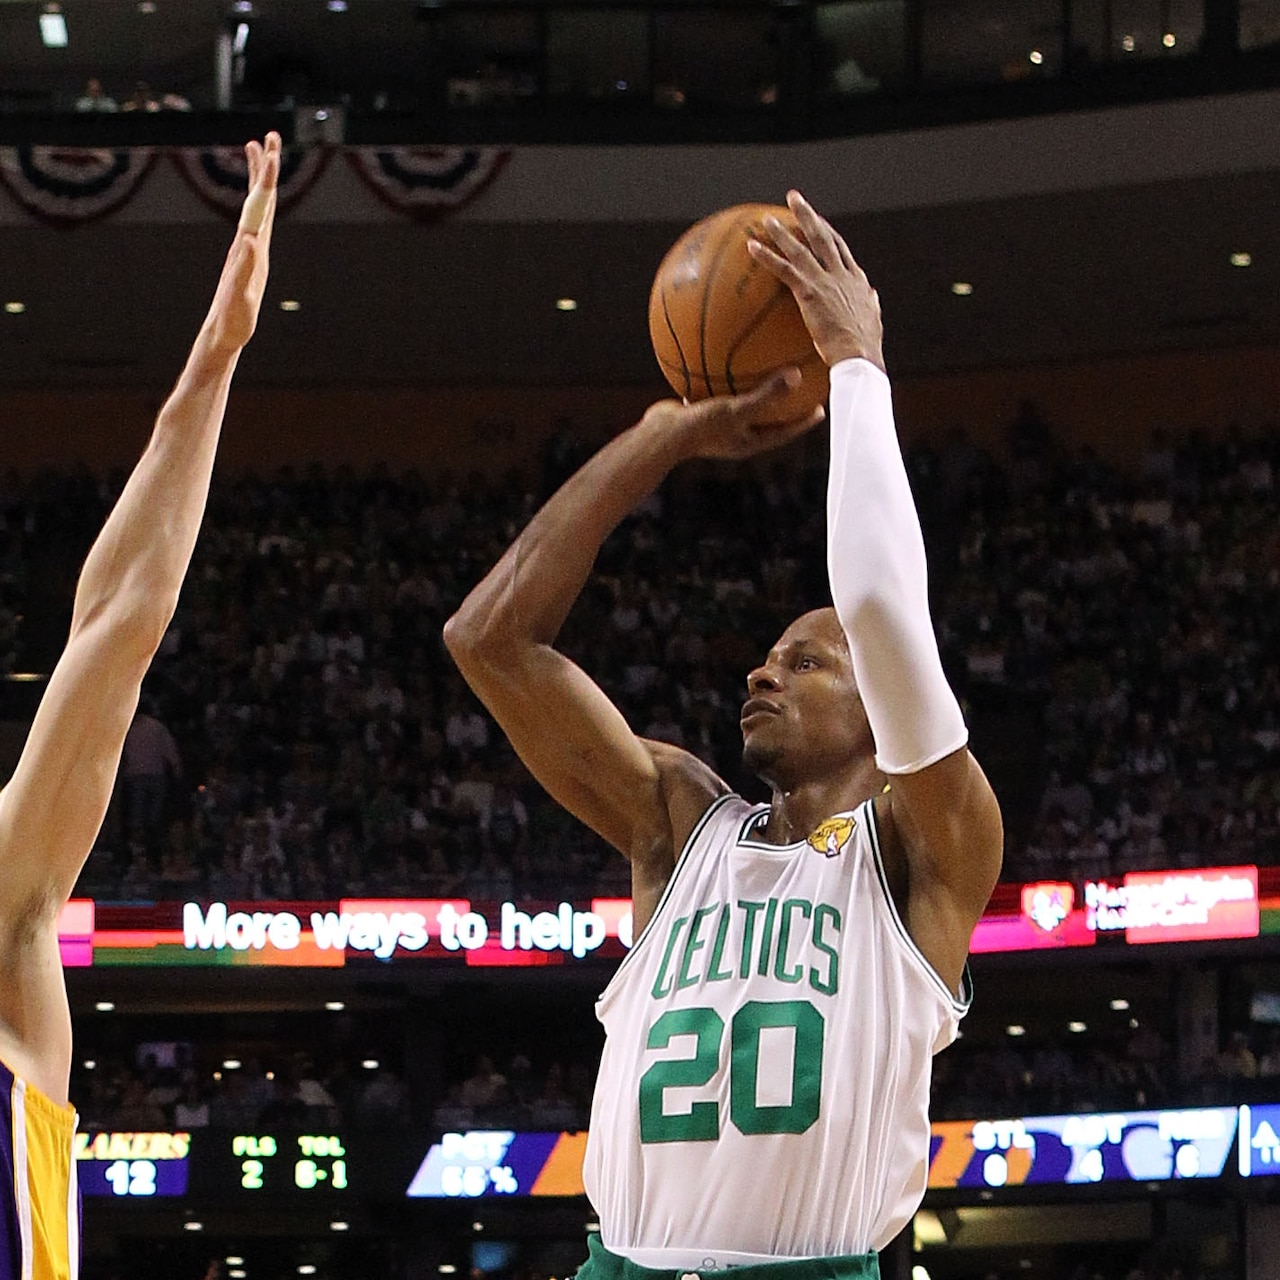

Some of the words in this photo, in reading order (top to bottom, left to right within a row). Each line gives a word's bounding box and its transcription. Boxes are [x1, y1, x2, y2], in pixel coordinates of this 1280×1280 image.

[182, 901, 301, 951] More
[311, 908, 430, 959] ways
[437, 903, 487, 951] to
[501, 902, 606, 959] help
[651, 897, 841, 1000] CELTICS
[639, 1000, 825, 1144] 20
[75, 1132, 191, 1160] LAKERS
[972, 1119, 1035, 1150] STL
[105, 1160, 156, 1195] 12
[241, 1159, 263, 1189] 2
